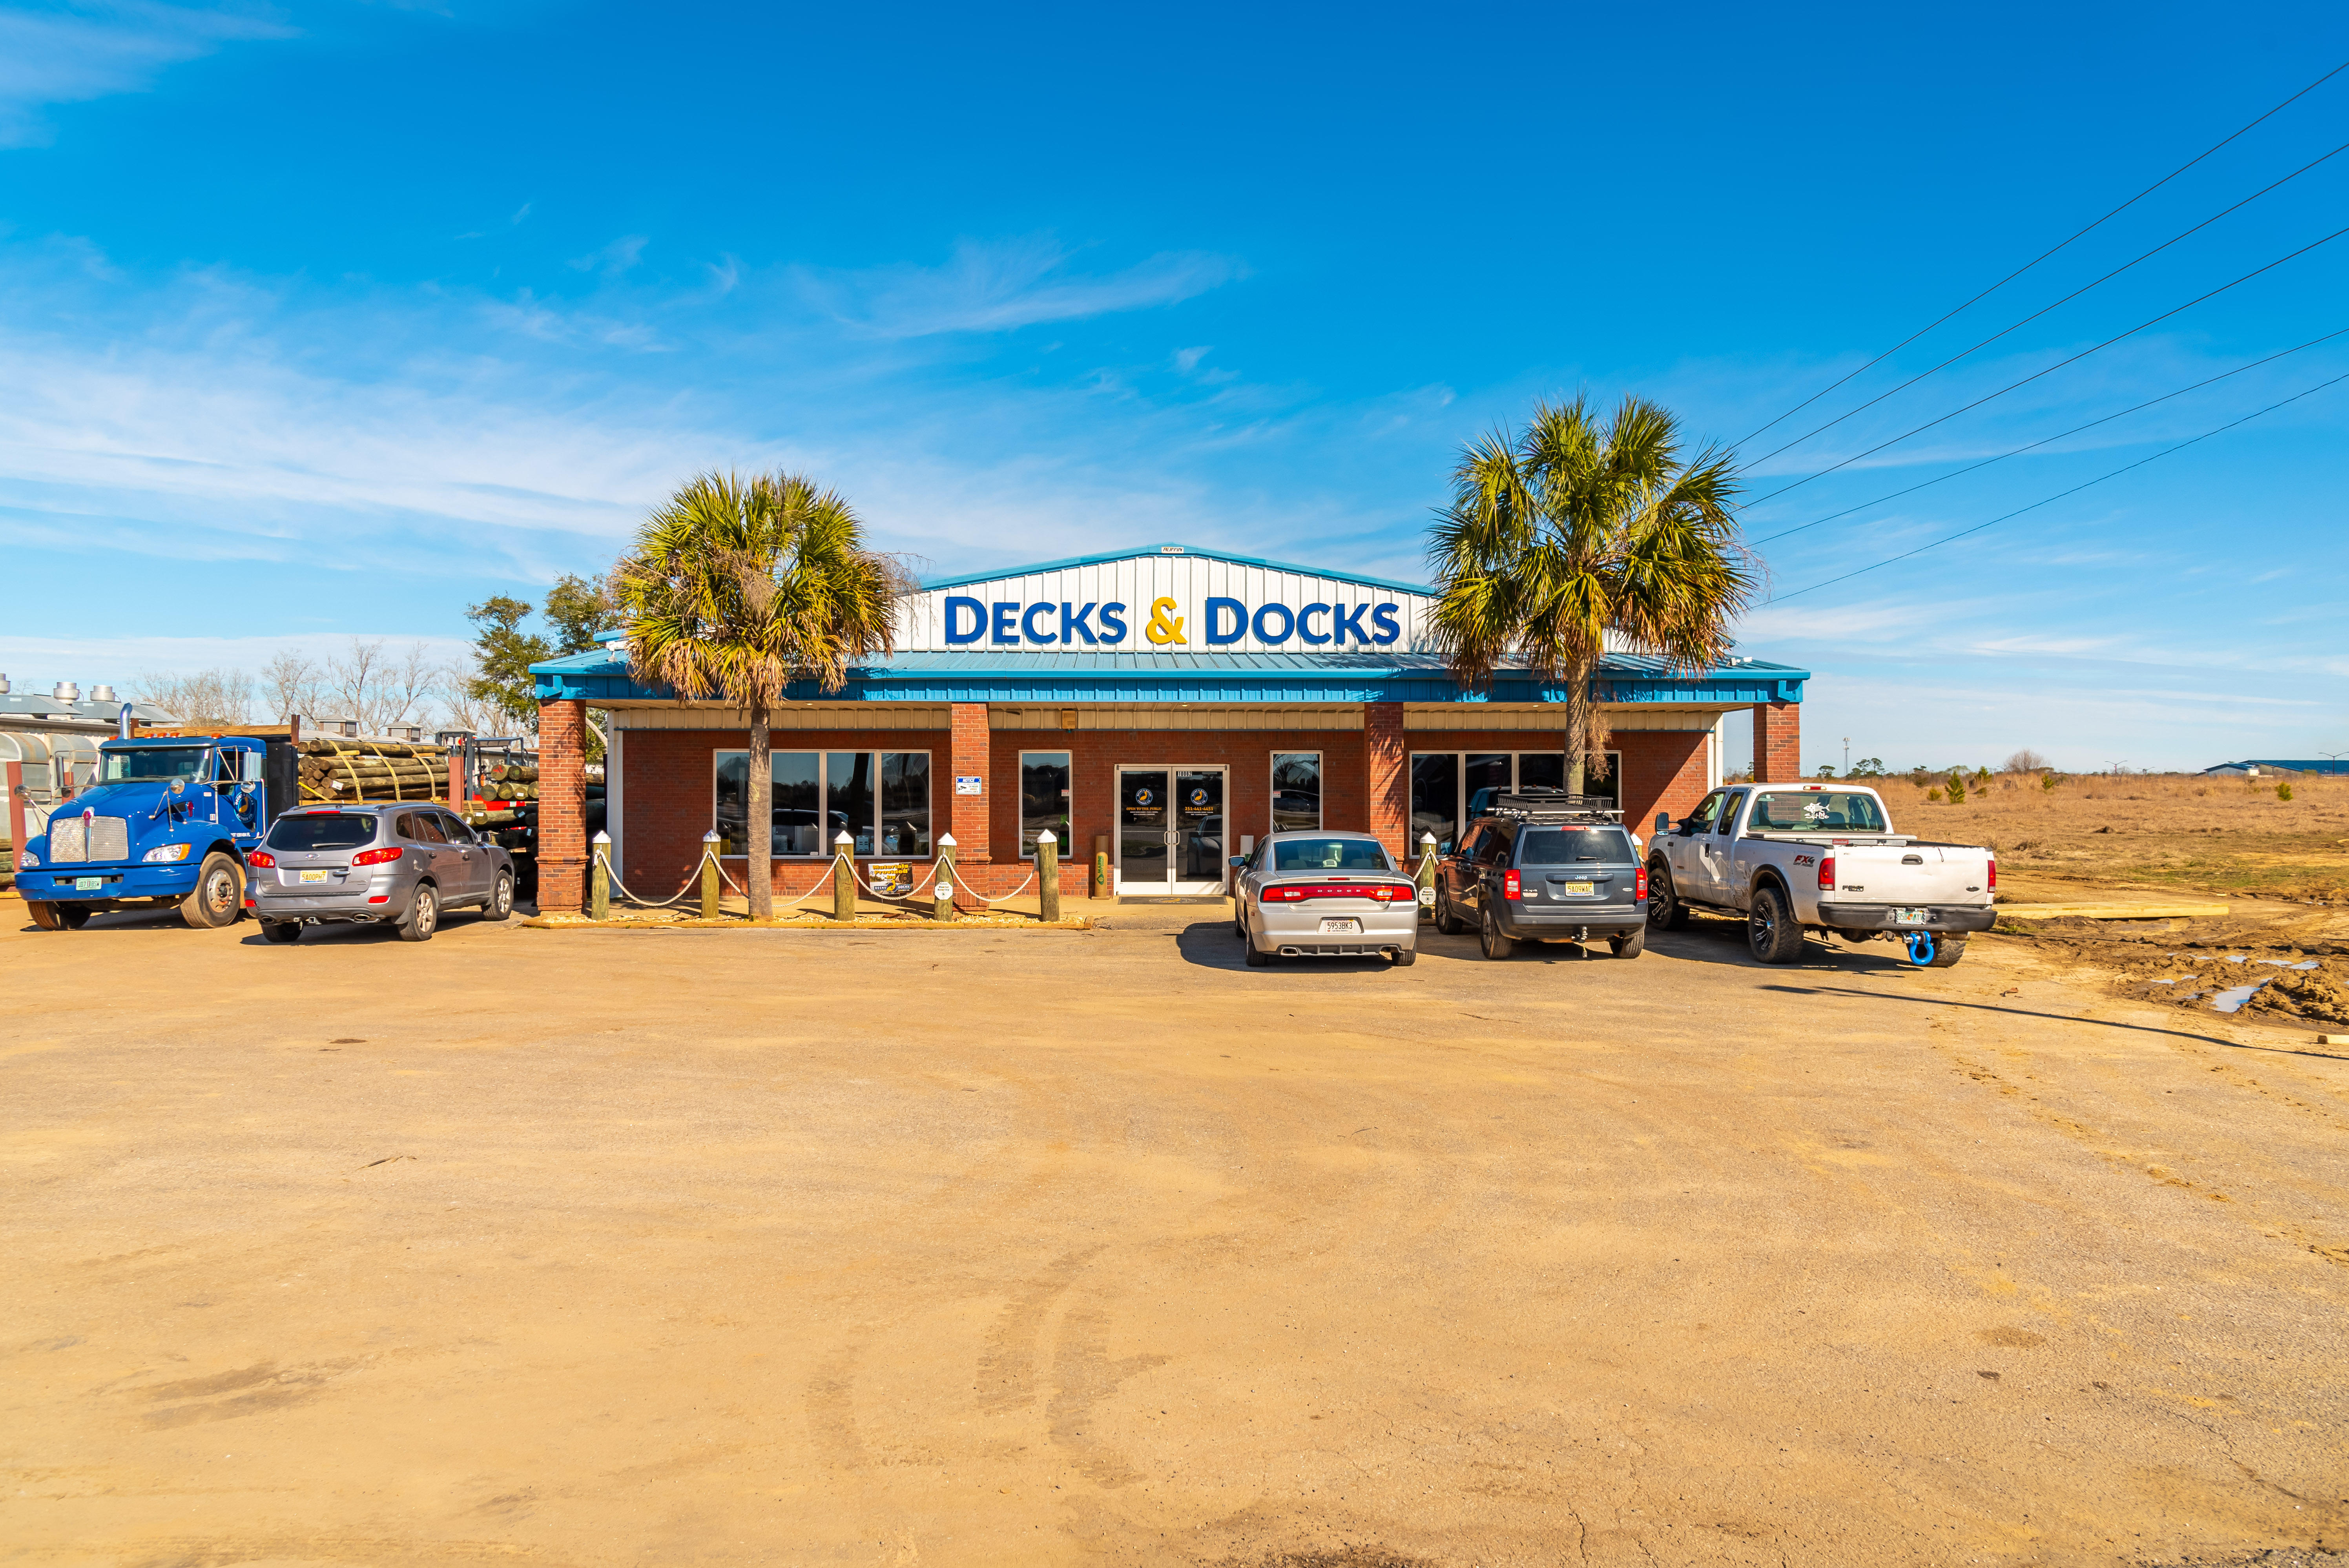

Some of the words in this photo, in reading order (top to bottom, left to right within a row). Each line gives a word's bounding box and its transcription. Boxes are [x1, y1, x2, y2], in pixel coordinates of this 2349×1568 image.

[945, 596, 1127, 645] DECKS
[1146, 596, 1188, 645] &
[1206, 596, 1401, 645] DOCKS
[1794, 855, 1815, 864] FX4
